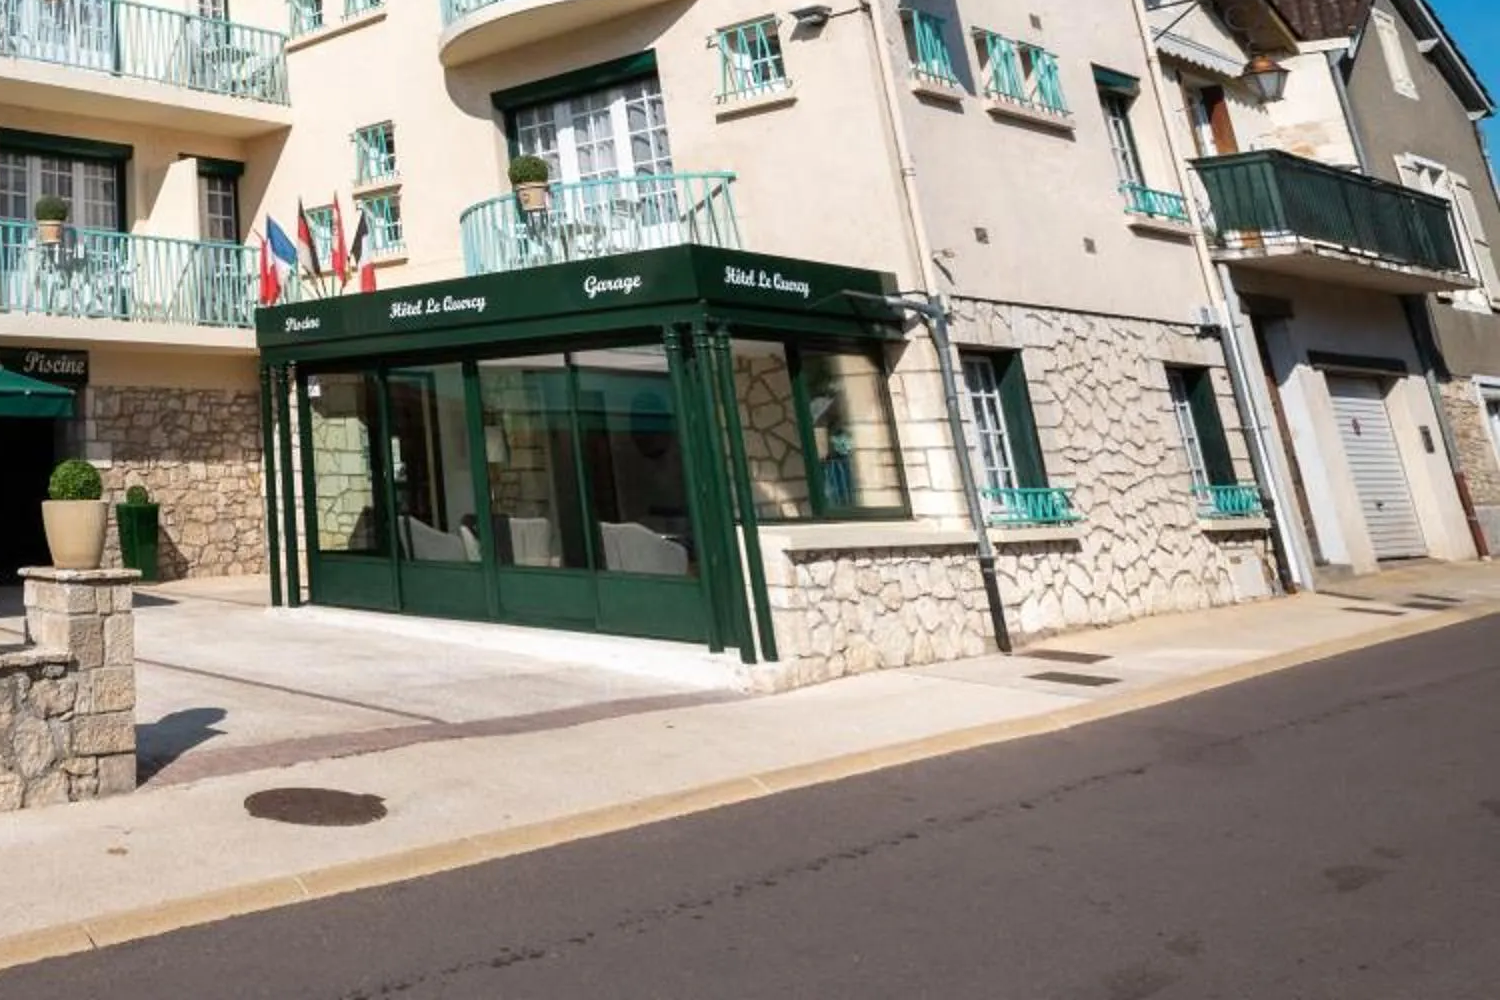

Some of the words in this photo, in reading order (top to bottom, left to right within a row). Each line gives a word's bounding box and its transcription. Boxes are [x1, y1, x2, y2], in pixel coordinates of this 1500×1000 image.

[583, 274, 642, 299] Garage
[723, 265, 756, 288] Hôtel
[758, 270, 772, 289] Le
[773, 273, 810, 298] Quercy
[389, 300, 422, 319] Hôtel
[425, 298, 441, 313] Le
[443, 295, 486, 313] Quercy
[23, 351, 85, 374] Piscine
